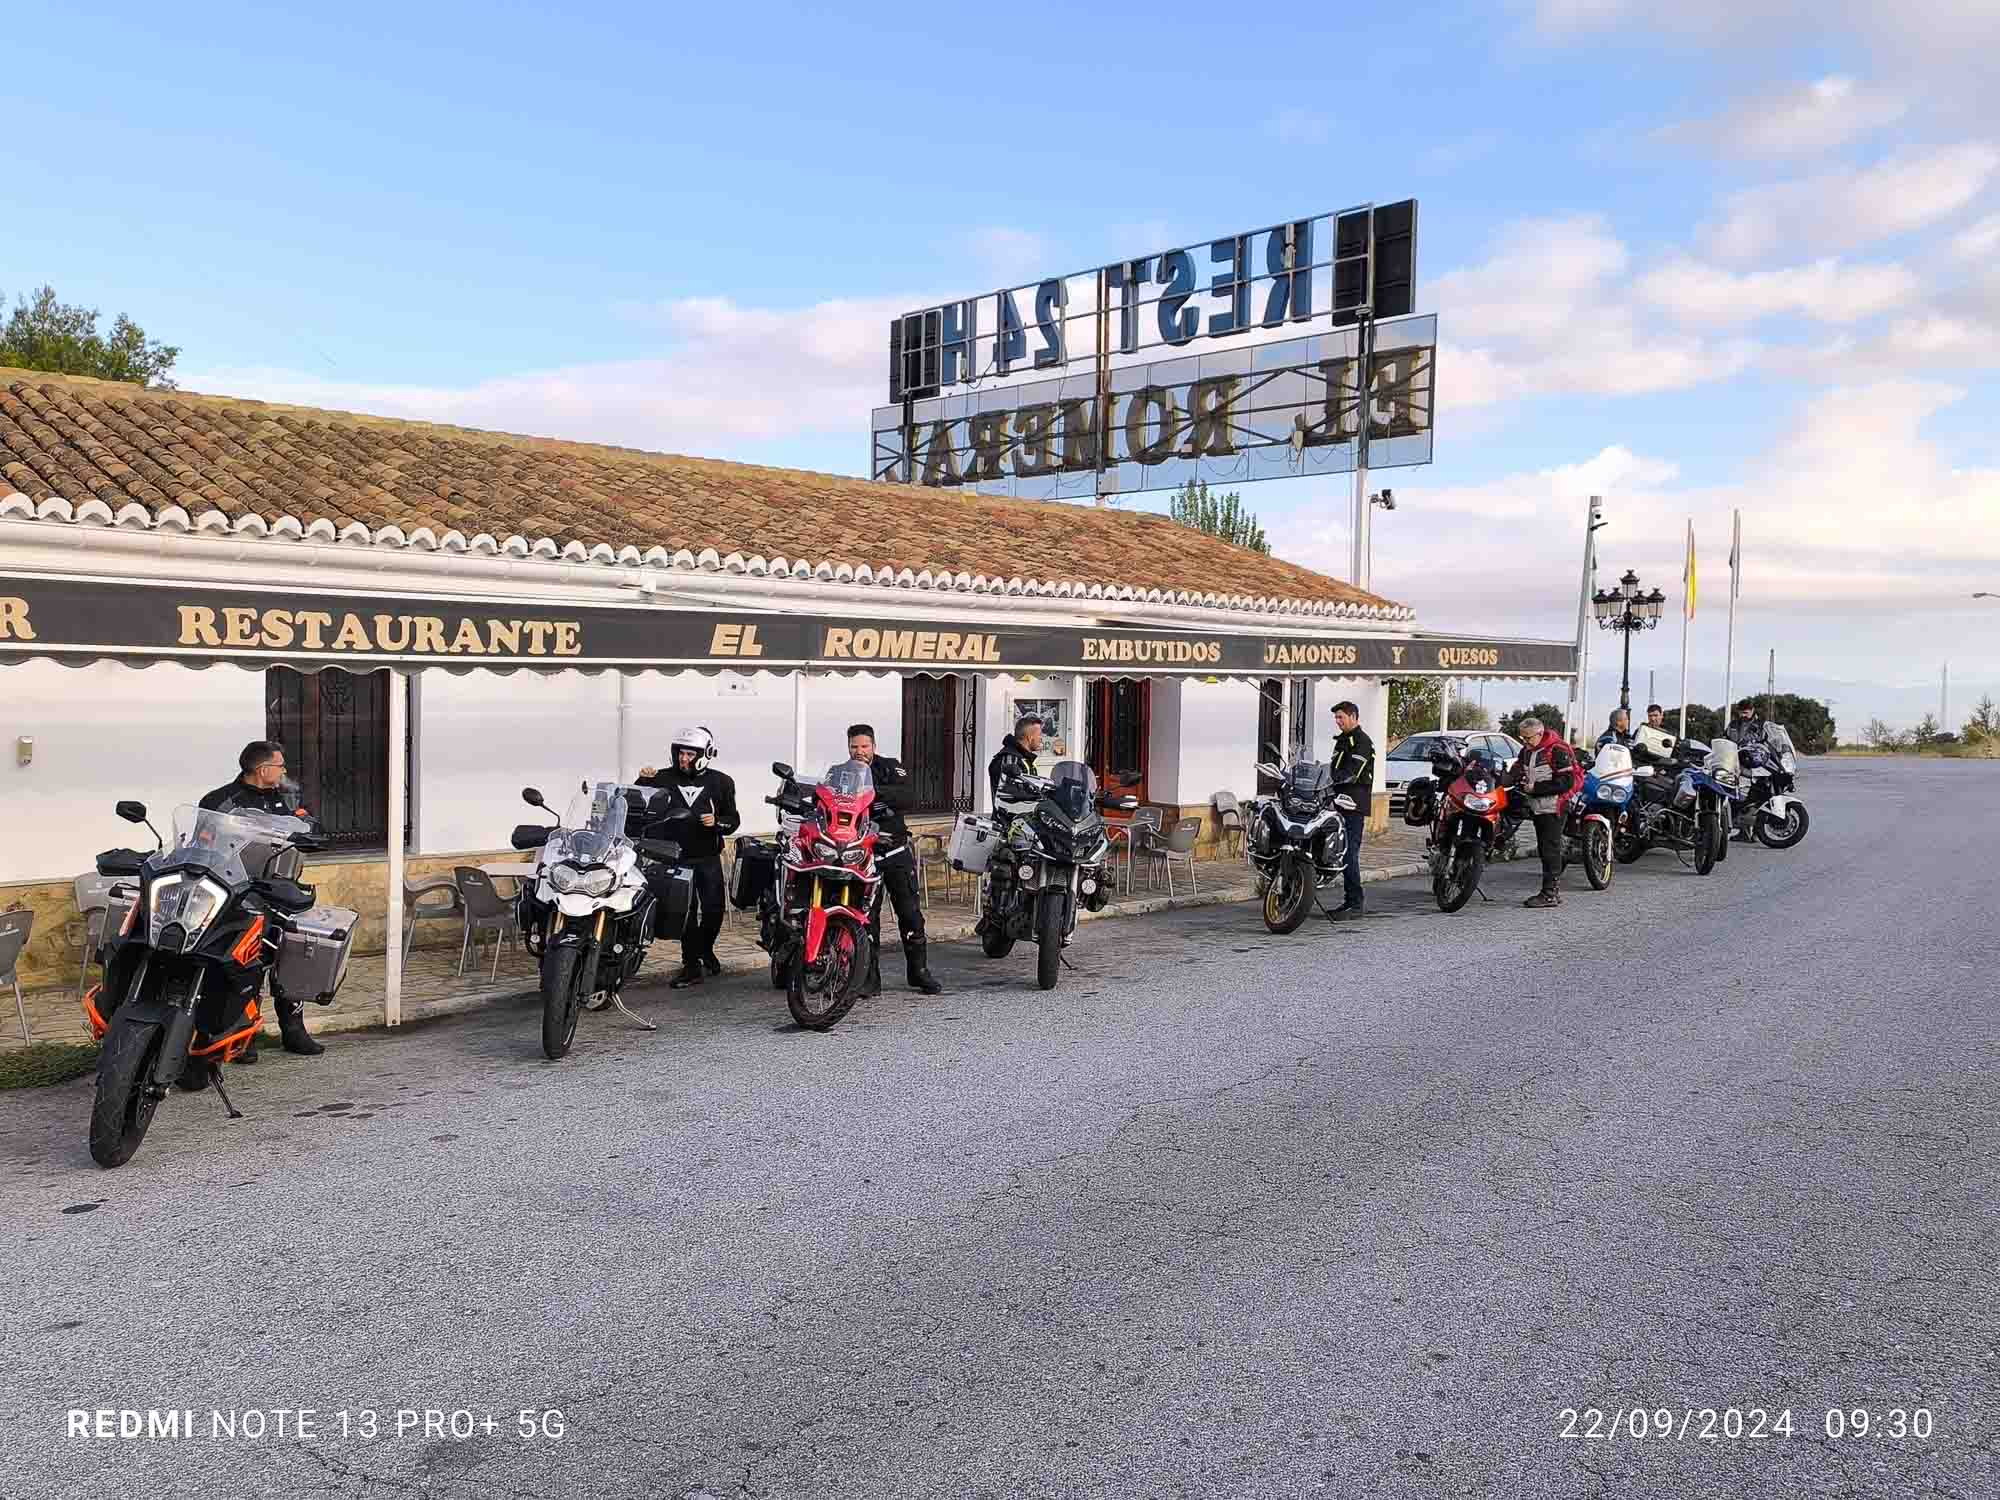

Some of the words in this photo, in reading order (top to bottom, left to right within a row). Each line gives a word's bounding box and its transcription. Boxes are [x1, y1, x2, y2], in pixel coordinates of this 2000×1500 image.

[177, 605, 581, 655] RESTAURANTE
[709, 623, 763, 656] EL
[823, 627, 1001, 662] ROMERAL
[1081, 637, 1222, 663] EMBUTIDOS
[1263, 645, 1357, 665] JAMONES
[1391, 646, 1404, 665] Y
[1438, 647, 1498, 668] QUESOS
